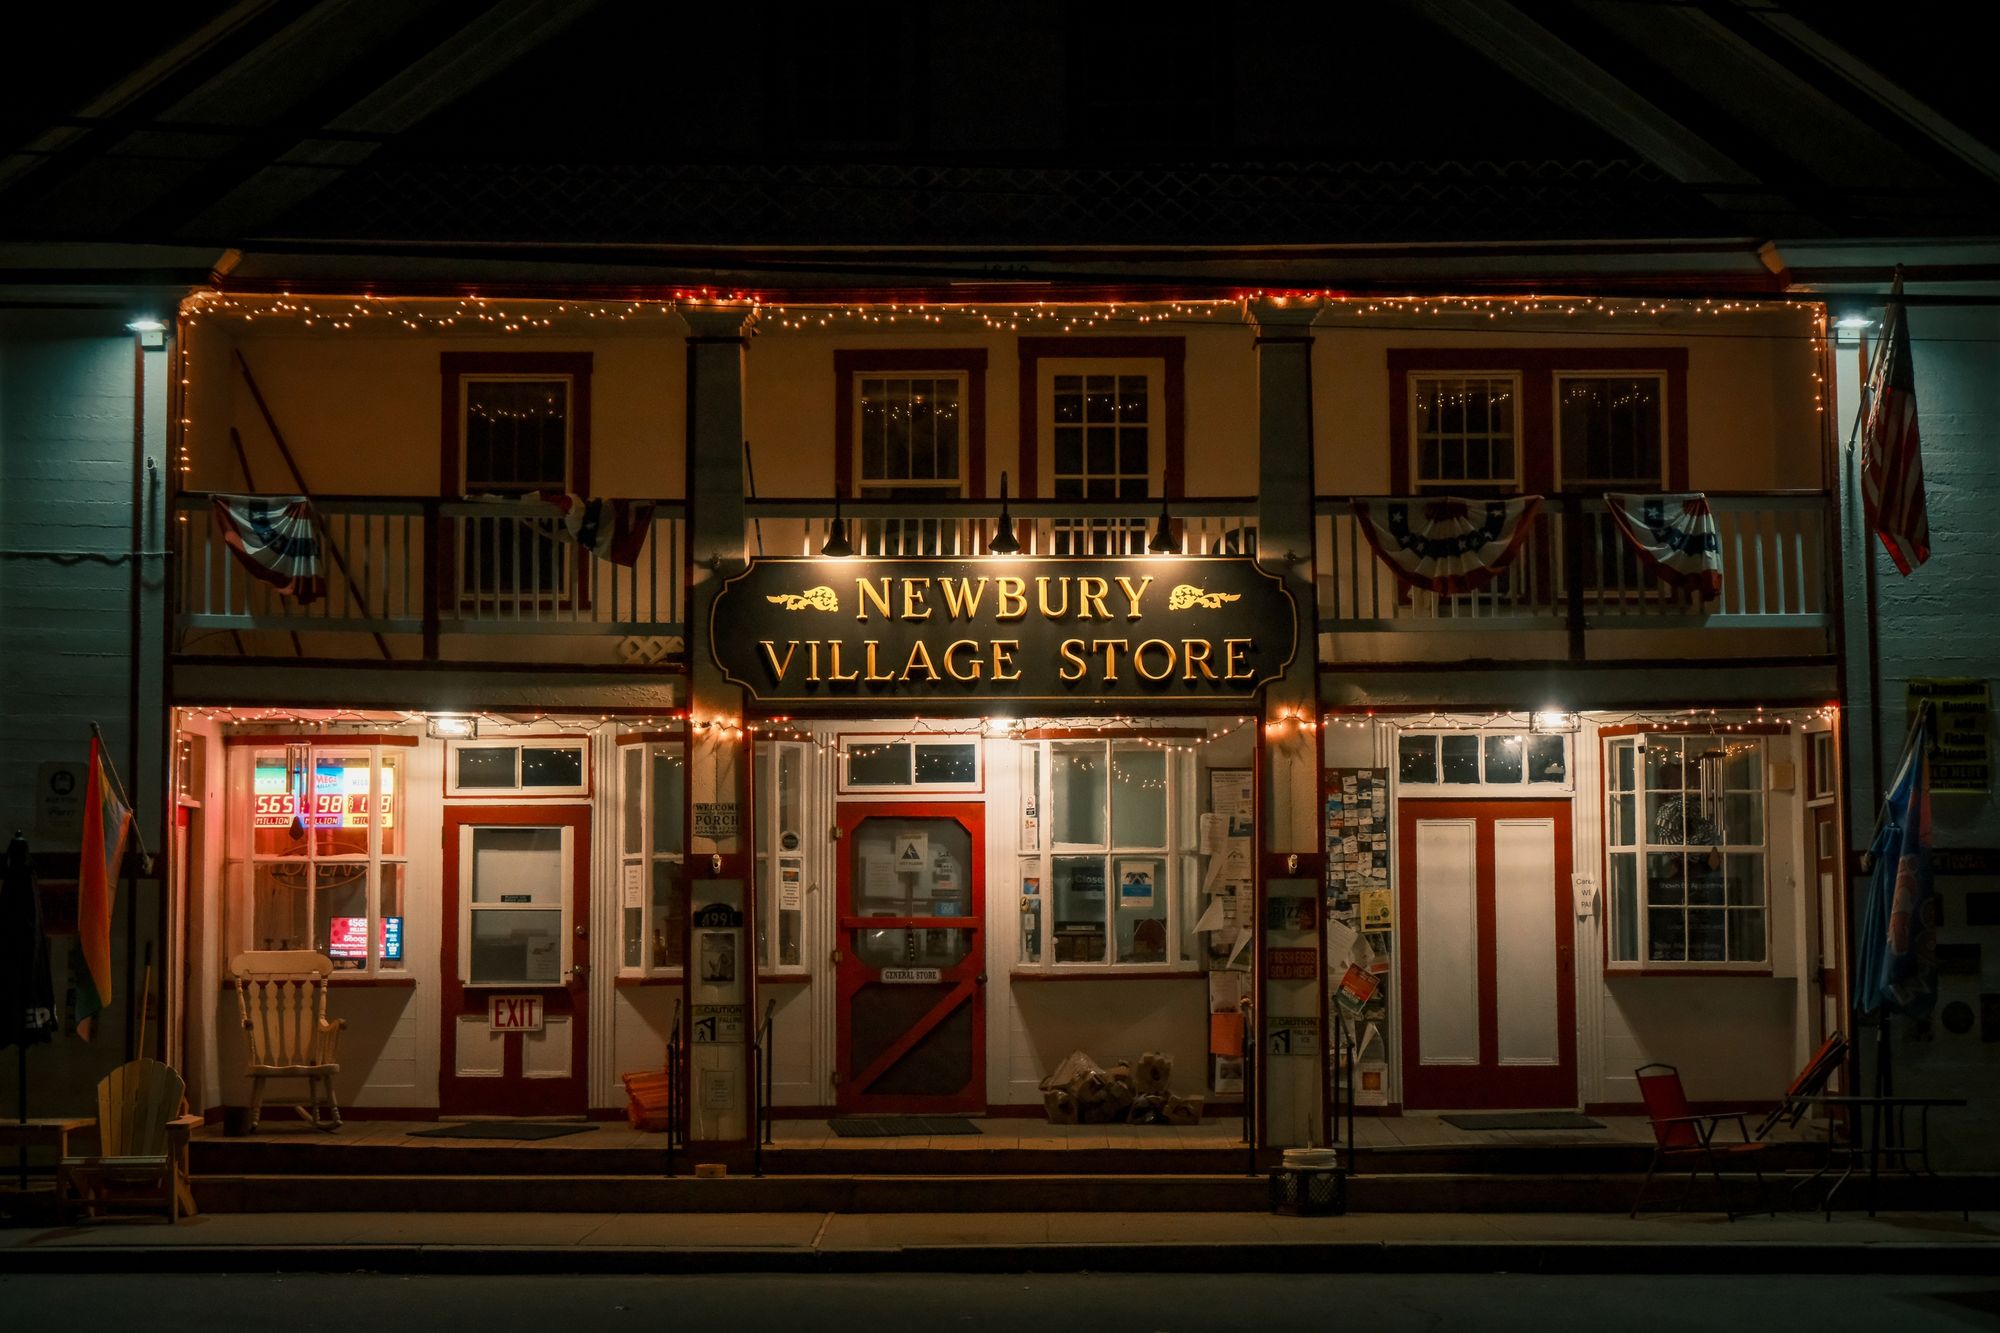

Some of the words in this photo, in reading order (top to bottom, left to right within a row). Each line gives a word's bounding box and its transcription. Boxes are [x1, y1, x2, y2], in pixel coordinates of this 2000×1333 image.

[855, 576, 1154, 620] NEWBURY
[759, 639, 1022, 682] VILLAGE
[1059, 638, 1256, 682] STORE
[255, 817, 290, 825] MILLION
[304, 817, 339, 825] MLLION
[695, 815, 740, 826] PORCH
[885, 971, 914, 980] GENERAL
[916, 971, 937, 980] STORE
[1270, 965, 1292, 977] SOLD
[1293, 965, 1315, 977] HERE
[495, 999, 536, 1027] EXIT
[703, 1006, 743, 1014] CAUTION
[1278, 1017, 1317, 1026] CAUTION
